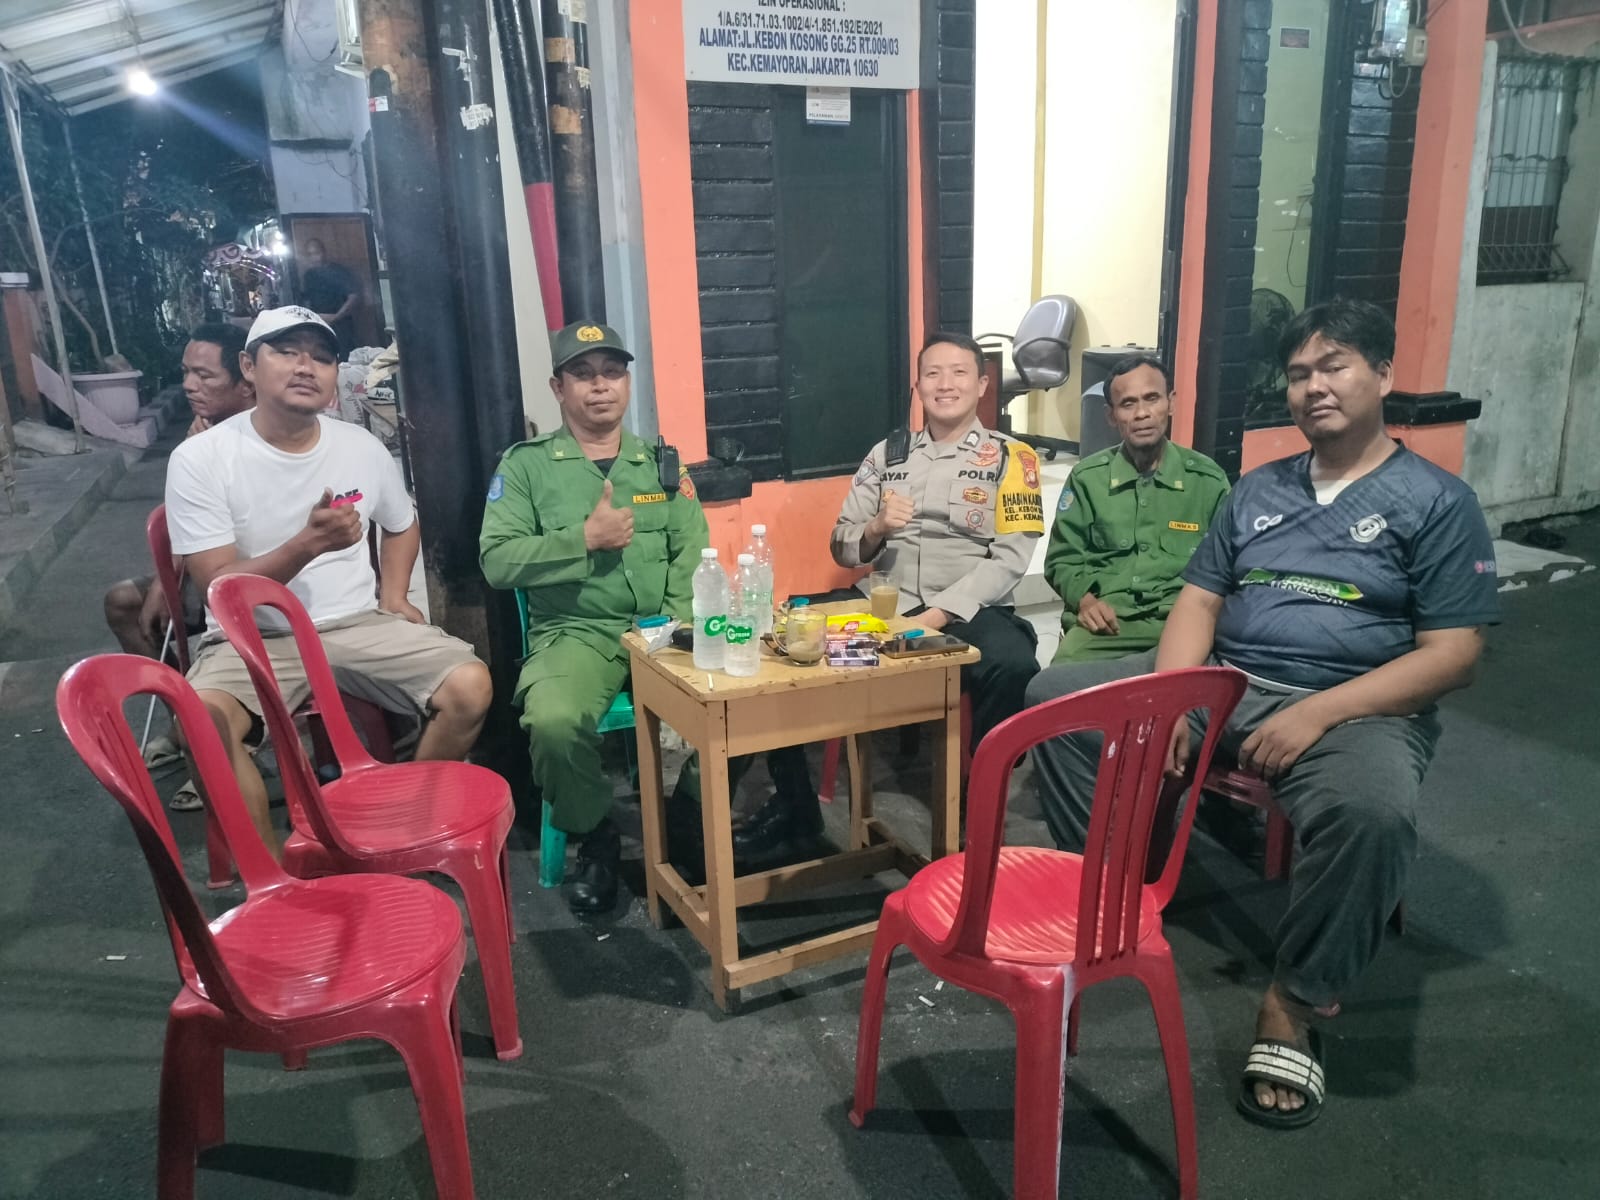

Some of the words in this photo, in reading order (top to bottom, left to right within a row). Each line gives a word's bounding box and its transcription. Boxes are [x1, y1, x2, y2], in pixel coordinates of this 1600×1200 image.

[790, 32, 829, 52] KOSONG
[831, 34, 857, 54] GG.25
[859, 36, 899, 56] RT.009/03
[727, 52, 852, 76] KEC.KEMAYORAN.JAKARTA
[853, 58, 879, 77] 10630
